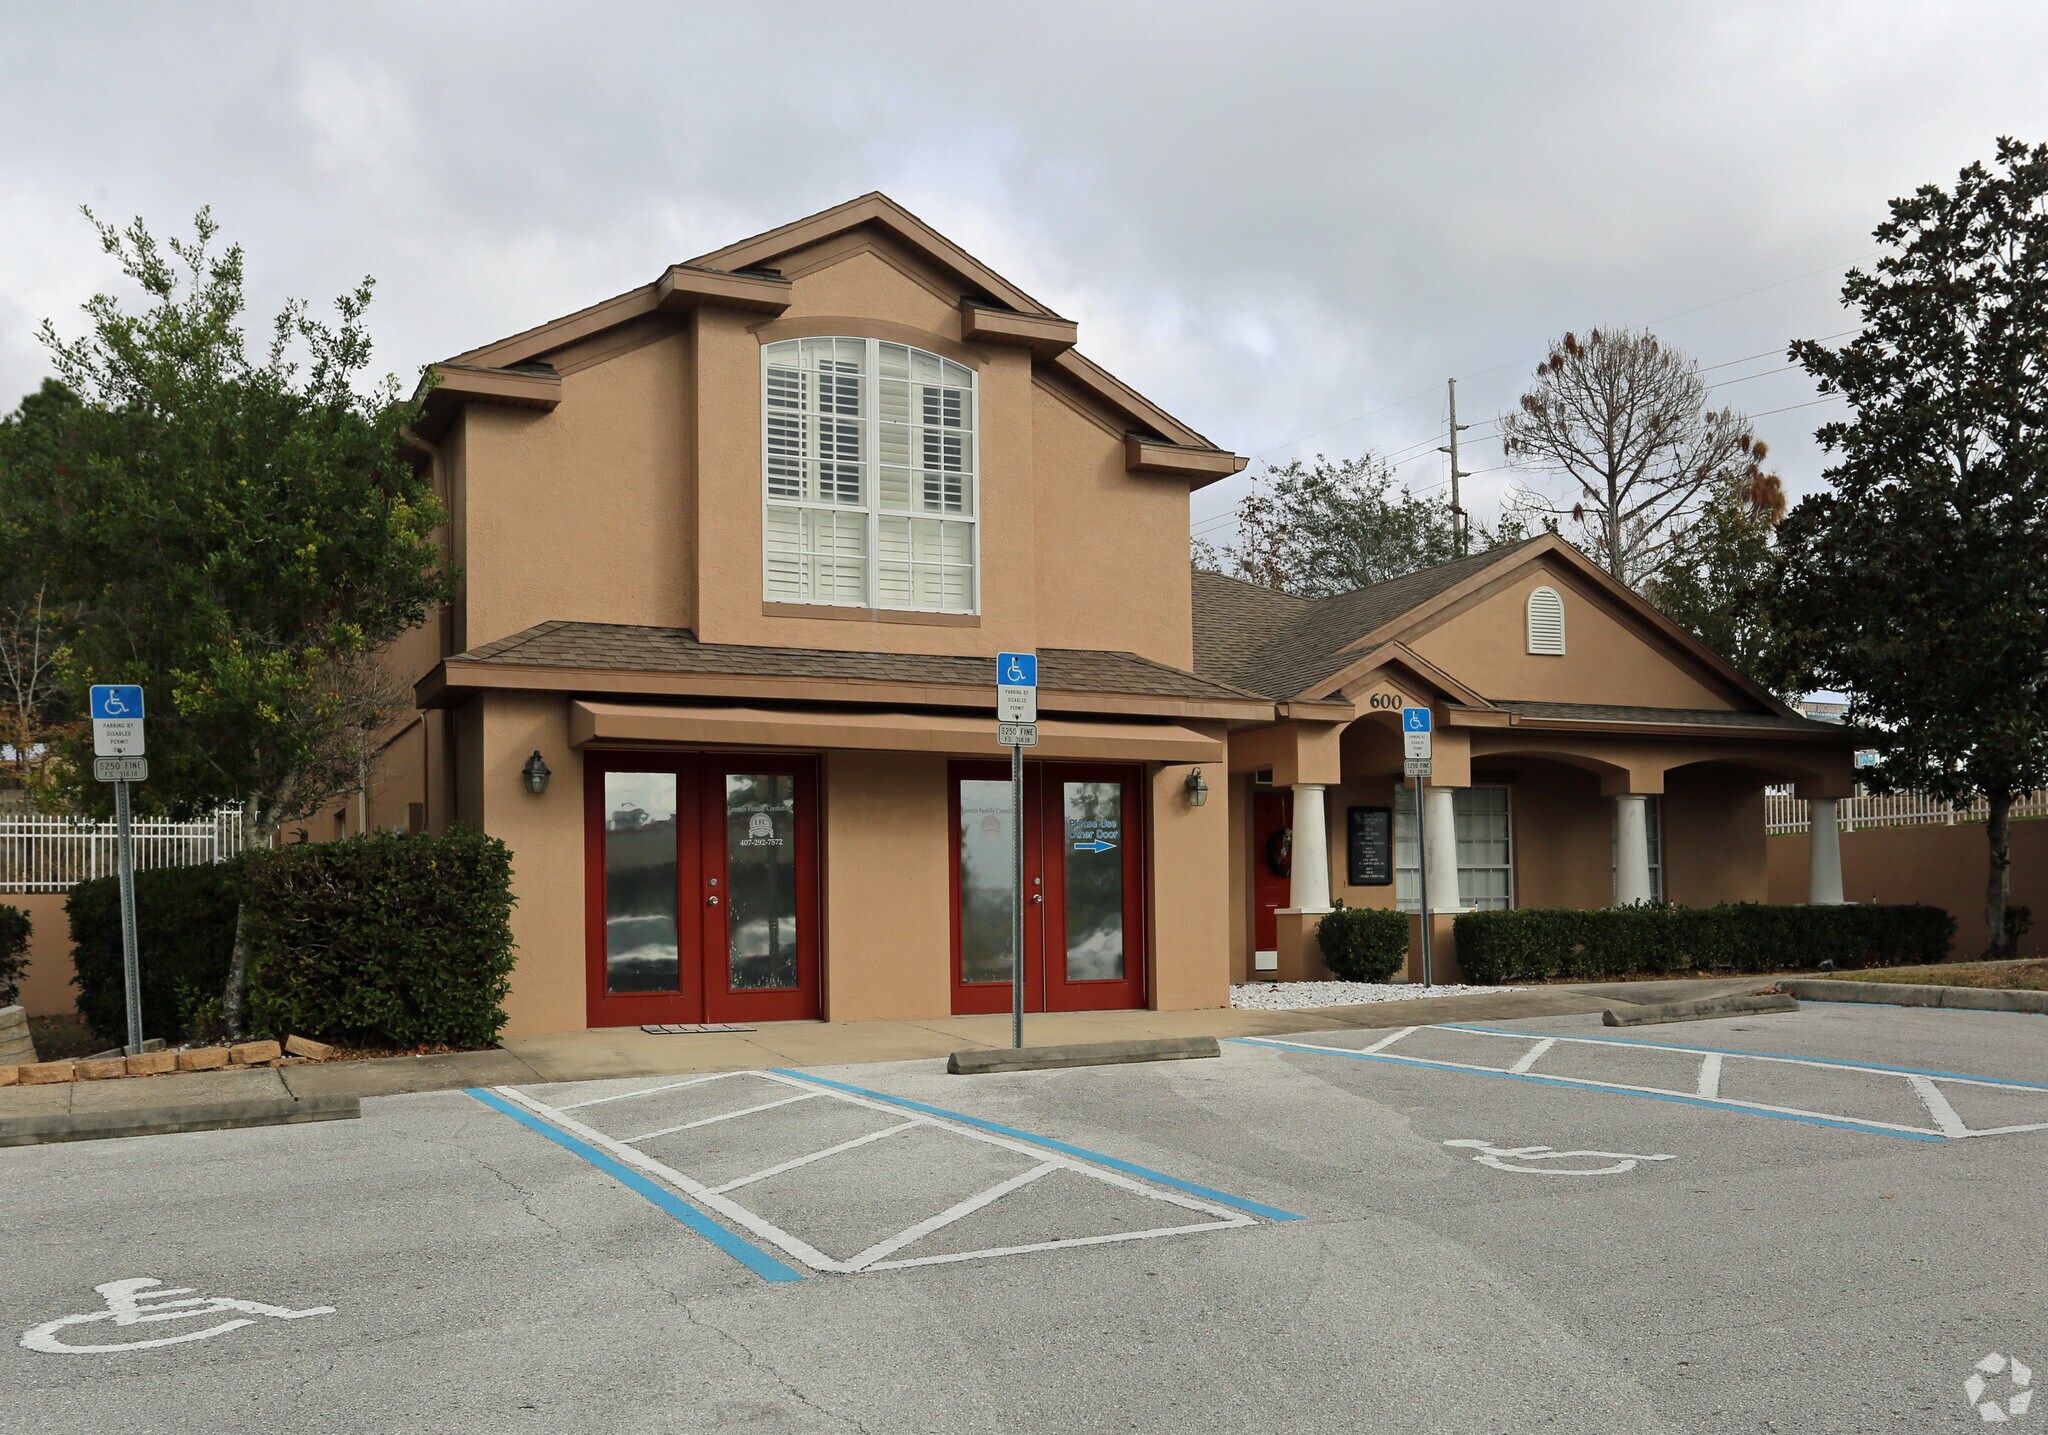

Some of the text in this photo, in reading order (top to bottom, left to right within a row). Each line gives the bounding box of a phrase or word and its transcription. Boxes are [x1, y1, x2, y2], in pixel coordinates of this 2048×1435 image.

[1370, 693, 1402, 710] 600
[1020, 728, 1034, 736] FINE
[125, 761, 142, 770] FINE
[747, 804, 765, 813] Family
[1069, 819, 1117, 828] Please Use
[1069, 829, 1118, 839] Other Door
[740, 838, 783, 846] 407-292-7572
